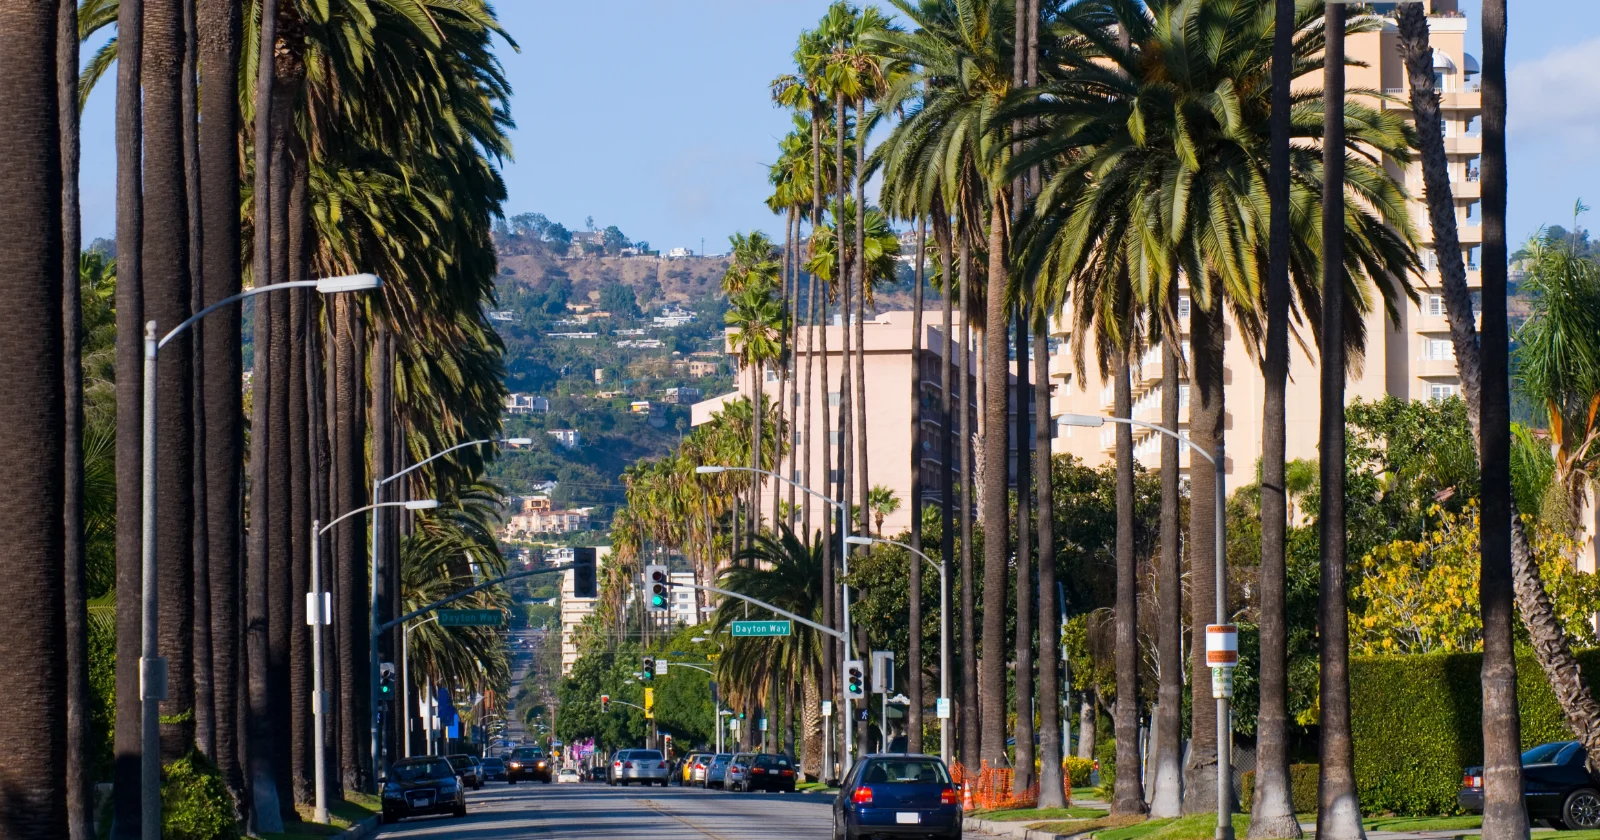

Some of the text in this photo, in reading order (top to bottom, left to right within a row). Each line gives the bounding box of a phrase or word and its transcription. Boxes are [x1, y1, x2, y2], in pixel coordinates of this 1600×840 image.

[443, 613, 498, 624] Dayton Way
[736, 625, 786, 634] Dayton Way
